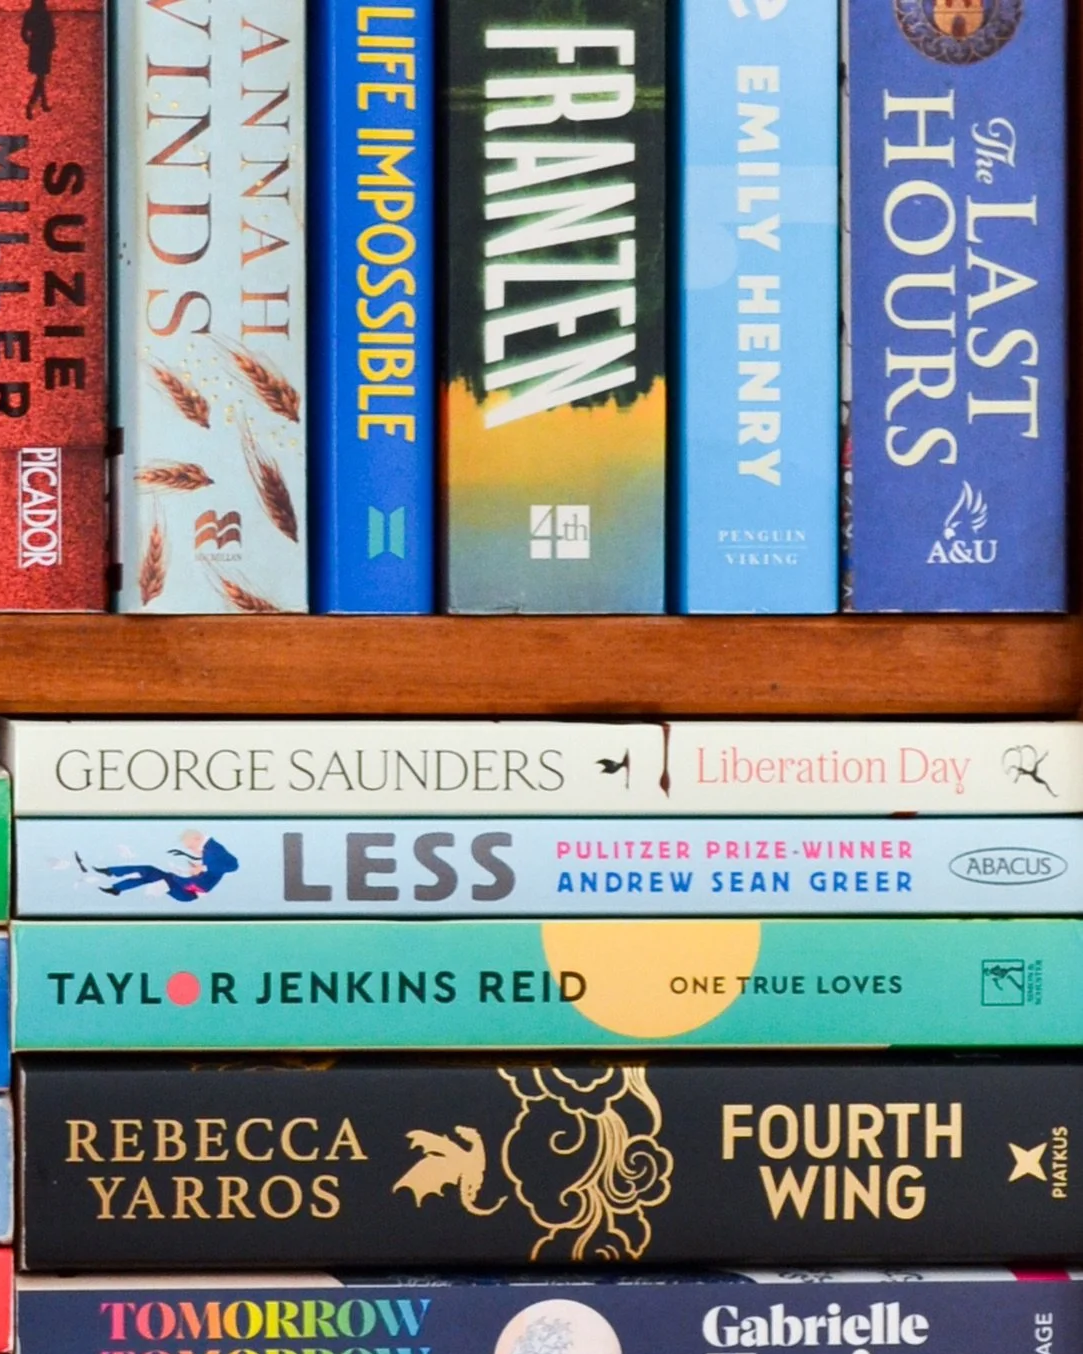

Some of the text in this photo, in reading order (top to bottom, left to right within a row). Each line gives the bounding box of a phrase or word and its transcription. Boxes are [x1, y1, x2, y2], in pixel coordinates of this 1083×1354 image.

[240, 16, 290, 341] ANNAH
[737, 65, 781, 250] EMILY
[357, 7, 416, 442] LIFE IMPOSSIBLE
[484, 28, 635, 430] FRANZEN
[42, 161, 86, 391] SUZIE
[882, 88, 957, 466] HOURS
[965, 116, 1039, 439] The LAST
[737, 275, 781, 486] HENRY
[23, 447, 56, 568] PICADOR
[717, 529, 806, 542] PENGUIN
[726, 553, 798, 565] VIKING
[926, 539, 999, 564] A&U
[54, 748, 566, 792] GEORGE SAUNDERS
[696, 745, 972, 796] Liberation Day
[282, 831, 517, 903] LESS
[556, 841, 913, 860] PULITZER PRIZE-WINNER
[966, 856, 1052, 876] ABACUS
[556, 871, 913, 893] ANDREW SEAN GREER
[255, 969, 457, 1005] JENKINS
[478, 970, 587, 1004] REID
[669, 975, 903, 996] ONE TRUE LOVES
[65, 1116, 369, 1163] REBECCA
[721, 1102, 962, 1159] FOURTH
[1051, 1126, 1068, 1198] PIATKUS
[87, 1173, 342, 1220] YARROS
[759, 1164, 926, 1220] WING
[99, 1299, 432, 1340] TOMORROW
[702, 1301, 929, 1348] Gabrielle
